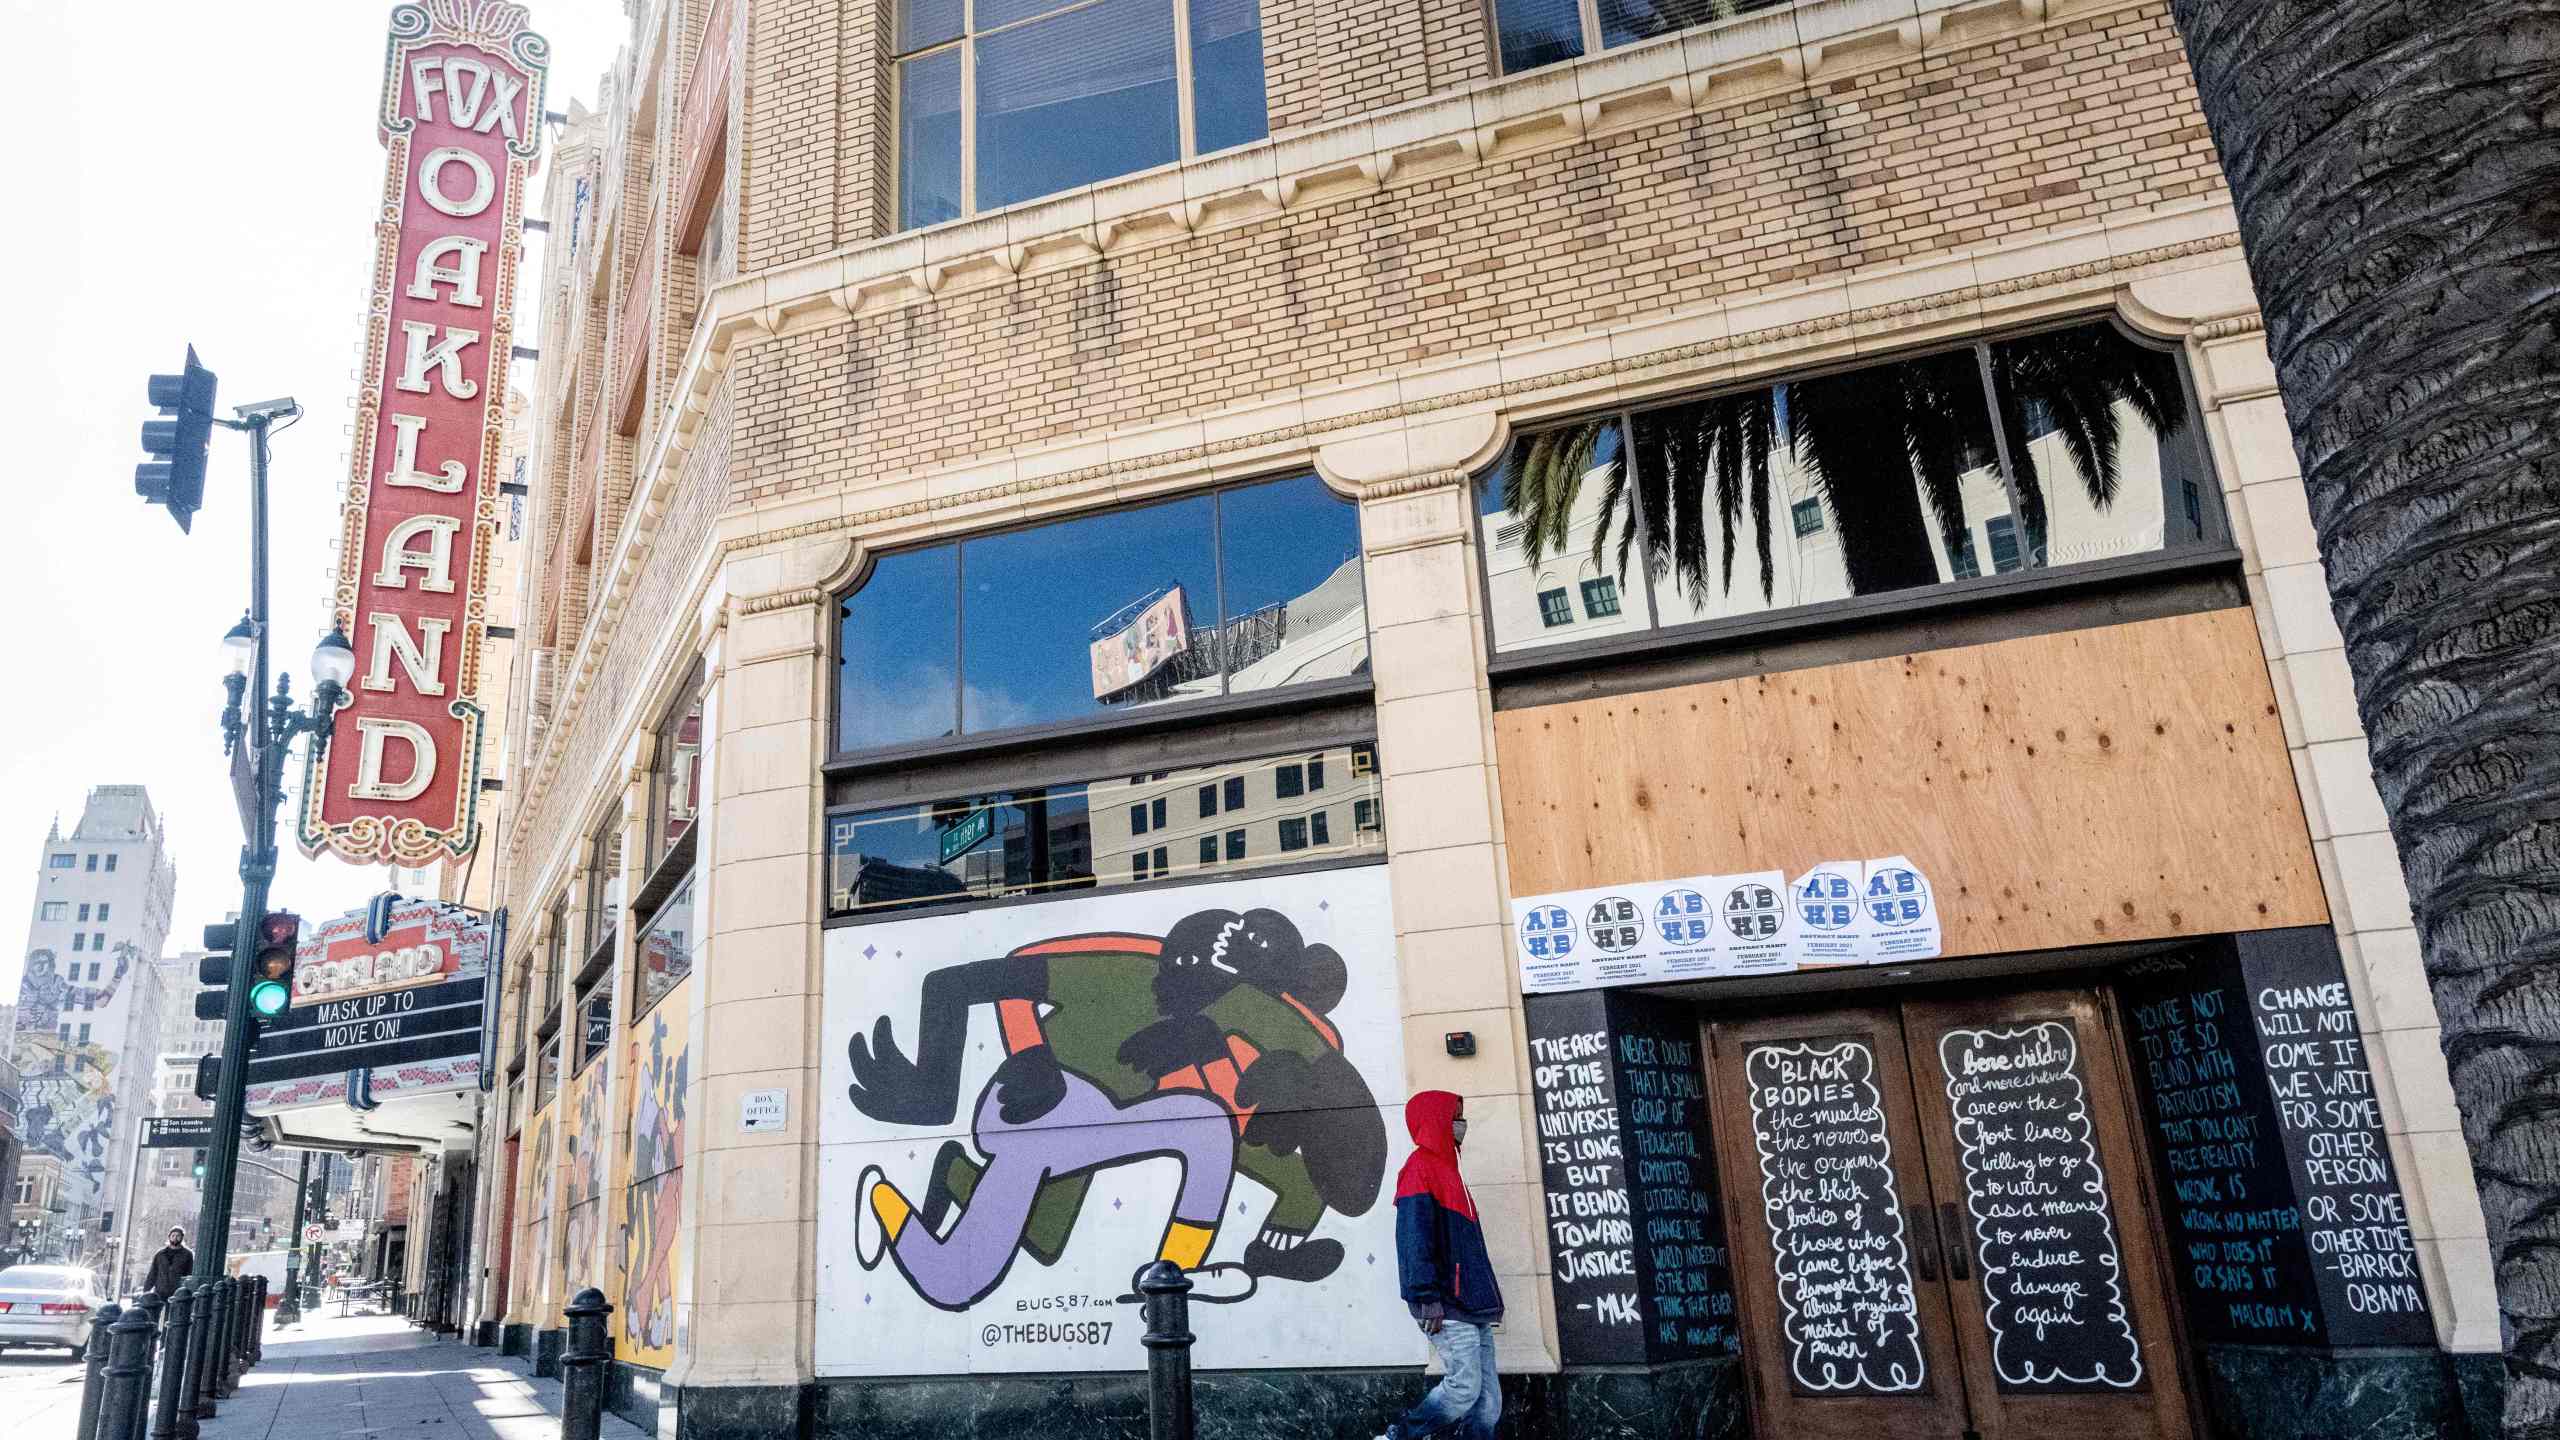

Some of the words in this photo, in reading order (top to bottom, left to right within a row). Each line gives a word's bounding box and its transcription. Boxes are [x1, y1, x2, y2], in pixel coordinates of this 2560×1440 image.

[410, 56, 524, 138] FOX
[348, 146, 496, 801] OAKLAND
[296, 944, 444, 994] OAKLAND
[318, 999, 361, 1024] MASK
[366, 995, 387, 1016] UP
[394, 991, 414, 1011] TO
[2190, 989, 2225, 1020] NOT
[2259, 982, 2349, 1011] CHANGE
[324, 1024, 369, 1048] MOVE
[374, 1019, 401, 1040] ON!
[2258, 1014, 2311, 1036] WILL
[2317, 1010, 2354, 1033] NOT
[1530, 1037, 1572, 1062] THE
[1571, 1031, 1607, 1058] ARC
[1620, 1034, 1658, 1064] NEVER
[1661, 1039, 1693, 1066] DOUBT
[2139, 1035, 2164, 1060] TO
[2168, 1025, 2192, 1055] BE
[2194, 1021, 2219, 1050] SO
[2266, 1041, 2325, 1068] COME
[2329, 1039, 2359, 1065] IF
[1535, 1064, 1564, 1088] OF
[1565, 1061, 1606, 1085] THE
[1782, 1057, 1848, 1084] BLACK
[2149, 1058, 2192, 1090] BLIND
[2192, 1048, 2236, 1081] WITH
[1545, 1085, 1610, 1110] MORAL
[1625, 1070, 1657, 1096] THAT
[1662, 1071, 1671, 1097] A
[1671, 1072, 1703, 1100] SMALL
[1764, 1083, 1854, 1107] BODIES
[1955, 1076, 1983, 1096] and
[1983, 1077, 2025, 1090] more
[2269, 1071, 2313, 1098] WE
[2314, 1070, 2371, 1096] WAIT
[1632, 1098, 1666, 1124] GROUP
[1672, 1100, 1685, 1125] OF
[1968, 1102, 1998, 1115] are
[1998, 1100, 2023, 1112] on
[2027, 1093, 2067, 1111] the
[2156, 1080, 2241, 1118] PATRIOTISM
[1540, 1107, 1620, 1137] UNIVERSE
[1770, 1108, 1810, 1130] the
[1810, 1102, 1878, 1124] muscles
[2281, 1101, 2324, 1130] FOR
[2324, 1098, 2384, 1129] SOME
[1772, 1127, 1810, 1152] the
[1976, 1121, 2016, 1154] front
[2024, 1121, 2072, 1143] lines
[2159, 1118, 2193, 1143] THAT
[2195, 1117, 2222, 1142] YOU
[1544, 1142, 1572, 1164] IS
[1574, 1135, 1623, 1160] LONG,
[2308, 1131, 2379, 1158] OTHER
[1778, 1157, 1812, 1180] the
[1814, 1155, 1878, 1182] organs
[1982, 1151, 2036, 1179] willing
[2038, 1153, 2055, 1167] to
[2059, 1155, 2081, 1178] go
[2168, 1148, 2201, 1171] FACE
[2305, 1158, 2387, 1186] PERSON
[1566, 1165, 1612, 1187] BUT
[1986, 1178, 2003, 1196] to
[2007, 1180, 2058, 1196] war
[2174, 1175, 2221, 1203] WRONG
[2228, 1172, 2246, 1200] IS
[1546, 1192, 1570, 1218] IT
[1572, 1188, 1631, 1217] BENDS
[1645, 1188, 1690, 1212] CITIZENS
[1691, 1191, 1709, 1215] CAN
[1780, 1179, 1818, 1203] the
[1787, 1205, 1838, 1231] bodies
[1844, 1202, 1864, 1230] of
[1986, 1202, 2021, 1217] as
[2022, 1202, 2038, 1217] a
[2041, 1200, 2100, 1216] means
[2181, 1207, 2222, 1230] WRONG
[2226, 1211, 2244, 1233] NO
[2247, 1206, 2301, 1231] MATTER
[2307, 1195, 2343, 1223] OR
[2349, 1193, 2407, 1223] SOME
[1553, 1219, 1634, 1247] TOWARD
[1648, 1217, 1684, 1242] CHANGE
[1685, 1219, 1704, 1240] THE
[1788, 1232, 1845, 1256] those
[1849, 1230, 1891, 1250] who
[1996, 1227, 2017, 1245] to
[2019, 1226, 2072, 1242] never
[2311, 1229, 2370, 1254] OTHER
[2366, 1225, 2415, 1252] TIME
[1650, 1245, 1683, 1269] WORLD
[2009, 1249, 2085, 1268] endure
[2188, 1242, 2216, 1262] WHO
[2223, 1240, 2256, 1263] DOES
[2257, 1237, 2273, 1263] IT
[1558, 1249, 1636, 1283] JUSTICE
[1798, 1258, 1844, 1276] came
[1848, 1253, 1896, 1281] before
[2194, 1267, 2216, 1289] OR
[2216, 1265, 2254, 1292] SAYS
[2263, 1267, 2278, 1290] IT
[1666, 1271, 1685, 1294] THE
[1687, 1269, 1708, 1292] ONLY
[1796, 1274, 1862, 1301] damaged
[1864, 1276, 1892, 1300] by
[2010, 1272, 2088, 1310] damage
[1653, 1296, 1685, 1320] THING
[1685, 1296, 1709, 1320] THAT
[2347, 1284, 2425, 1314] OBAMA
[1867, 1313, 1893, 1347] of
[2015, 1306, 2085, 1342] again
[2229, 1303, 2295, 1329] MALCOLM
[982, 1321, 1113, 1347] @THEBUGS87
[1659, 1320, 1679, 1345] HAS
[1810, 1341, 1868, 1363] power
